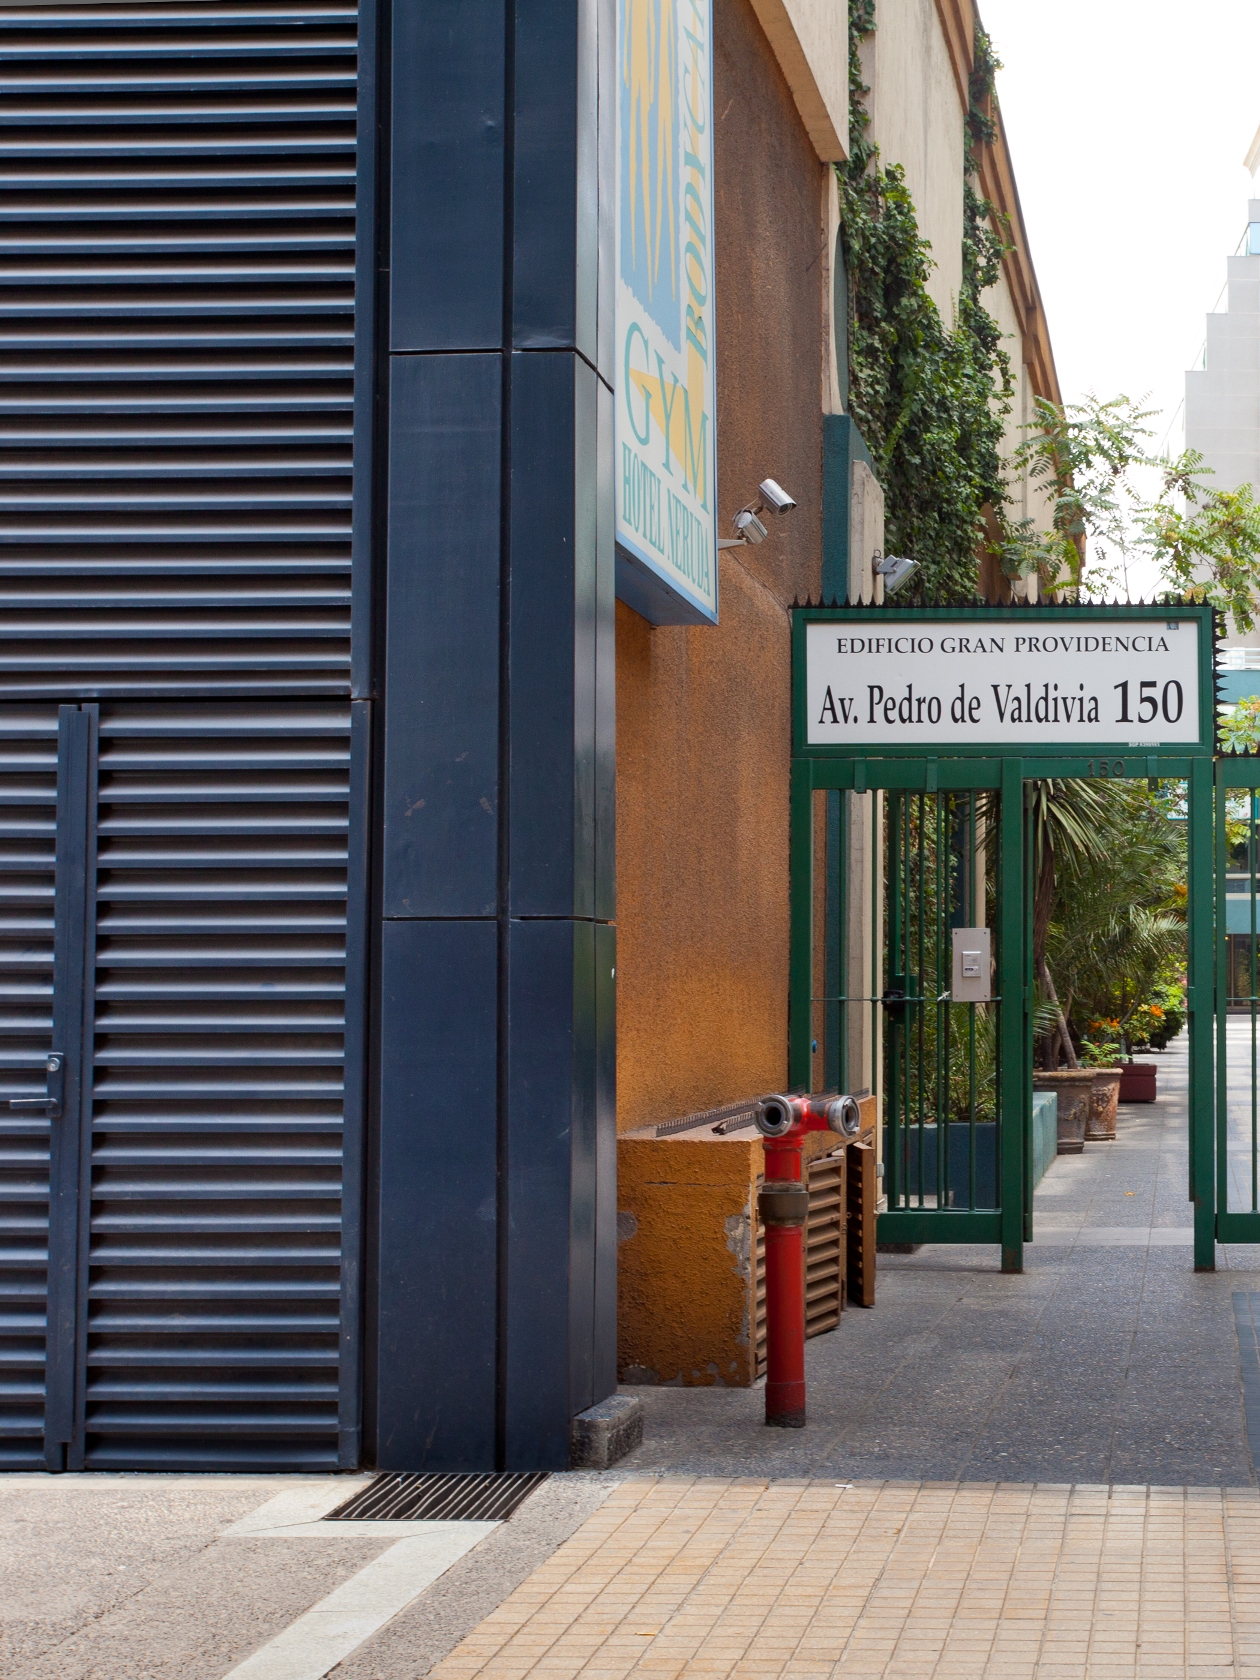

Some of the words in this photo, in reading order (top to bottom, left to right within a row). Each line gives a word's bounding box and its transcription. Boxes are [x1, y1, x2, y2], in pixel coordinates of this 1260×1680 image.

[624, 321, 710, 516] GYM
[622, 440, 665, 556] HOTEL
[666, 486, 711, 598] NERUDA
[836, 637, 934, 654] EDIFICIO
[940, 637, 1006, 654] GRAN
[1014, 636, 1170, 653] PROVIDENCIA
[817, 684, 859, 725] Av.
[866, 682, 942, 725] Pedro
[950, 682, 981, 724] de
[990, 682, 1101, 724] Valdivia
[1113, 679, 1184, 724] 150
[1088, 760, 1125, 777] 150
